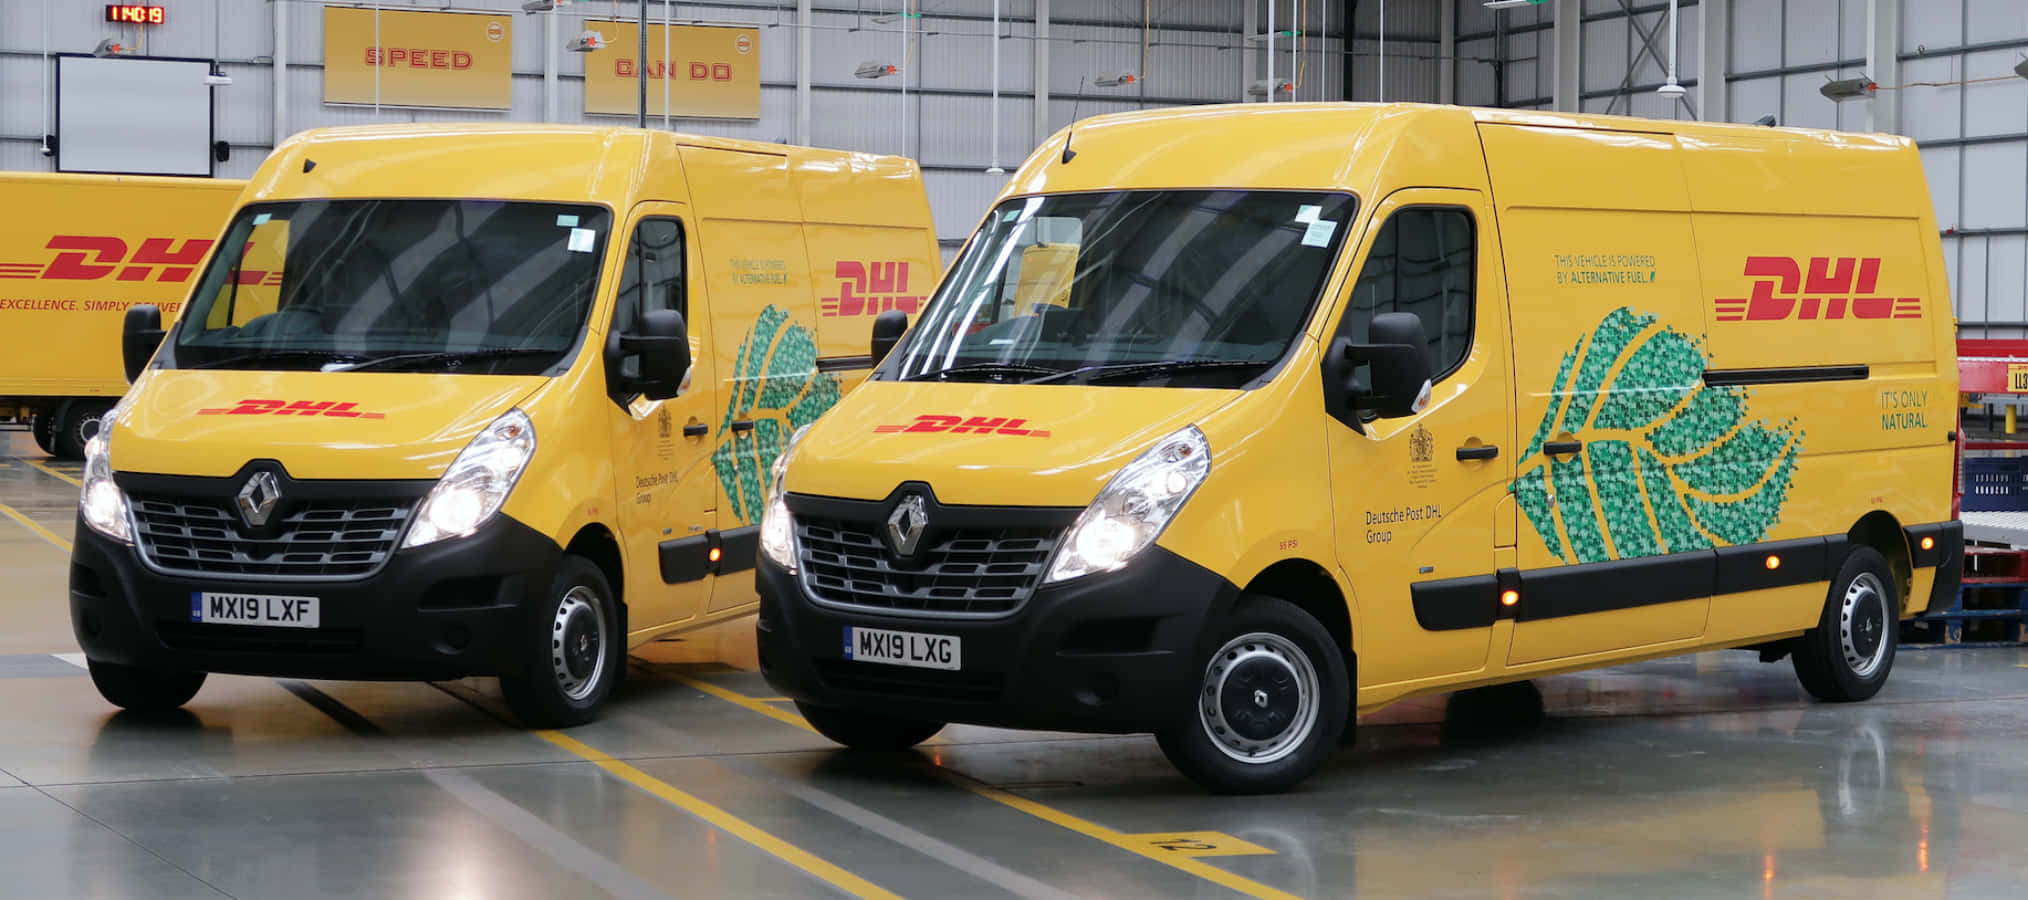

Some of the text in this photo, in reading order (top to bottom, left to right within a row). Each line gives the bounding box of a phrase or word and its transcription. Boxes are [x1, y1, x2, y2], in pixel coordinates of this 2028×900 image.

[365, 47, 472, 70] SPEED
[690, 62, 732, 81] DO
[1554, 255, 1573, 267] THIS
[1575, 255, 1608, 267] VEHICLE
[1618, 255, 1656, 267] POWERED
[1557, 272, 1568, 284] BY
[1571, 271, 1625, 284] ALTERNATIVE
[835, 261, 918, 317] DHL
[1744, 256, 1894, 321] DHL
[0, 298, 79, 311] EXCELLENCE.
[84, 300, 130, 312] SIMPLY
[225, 400, 362, 418] DHL
[1882, 391, 1928, 408] IT'S ONLY
[903, 415, 1032, 436] DHL
[1366, 504, 1442, 525] Deutsche Post DHL
[1366, 529, 1392, 544] Group
[210, 596, 310, 621] MX19 LXF
[860, 631, 951, 663] MX19 LXG
